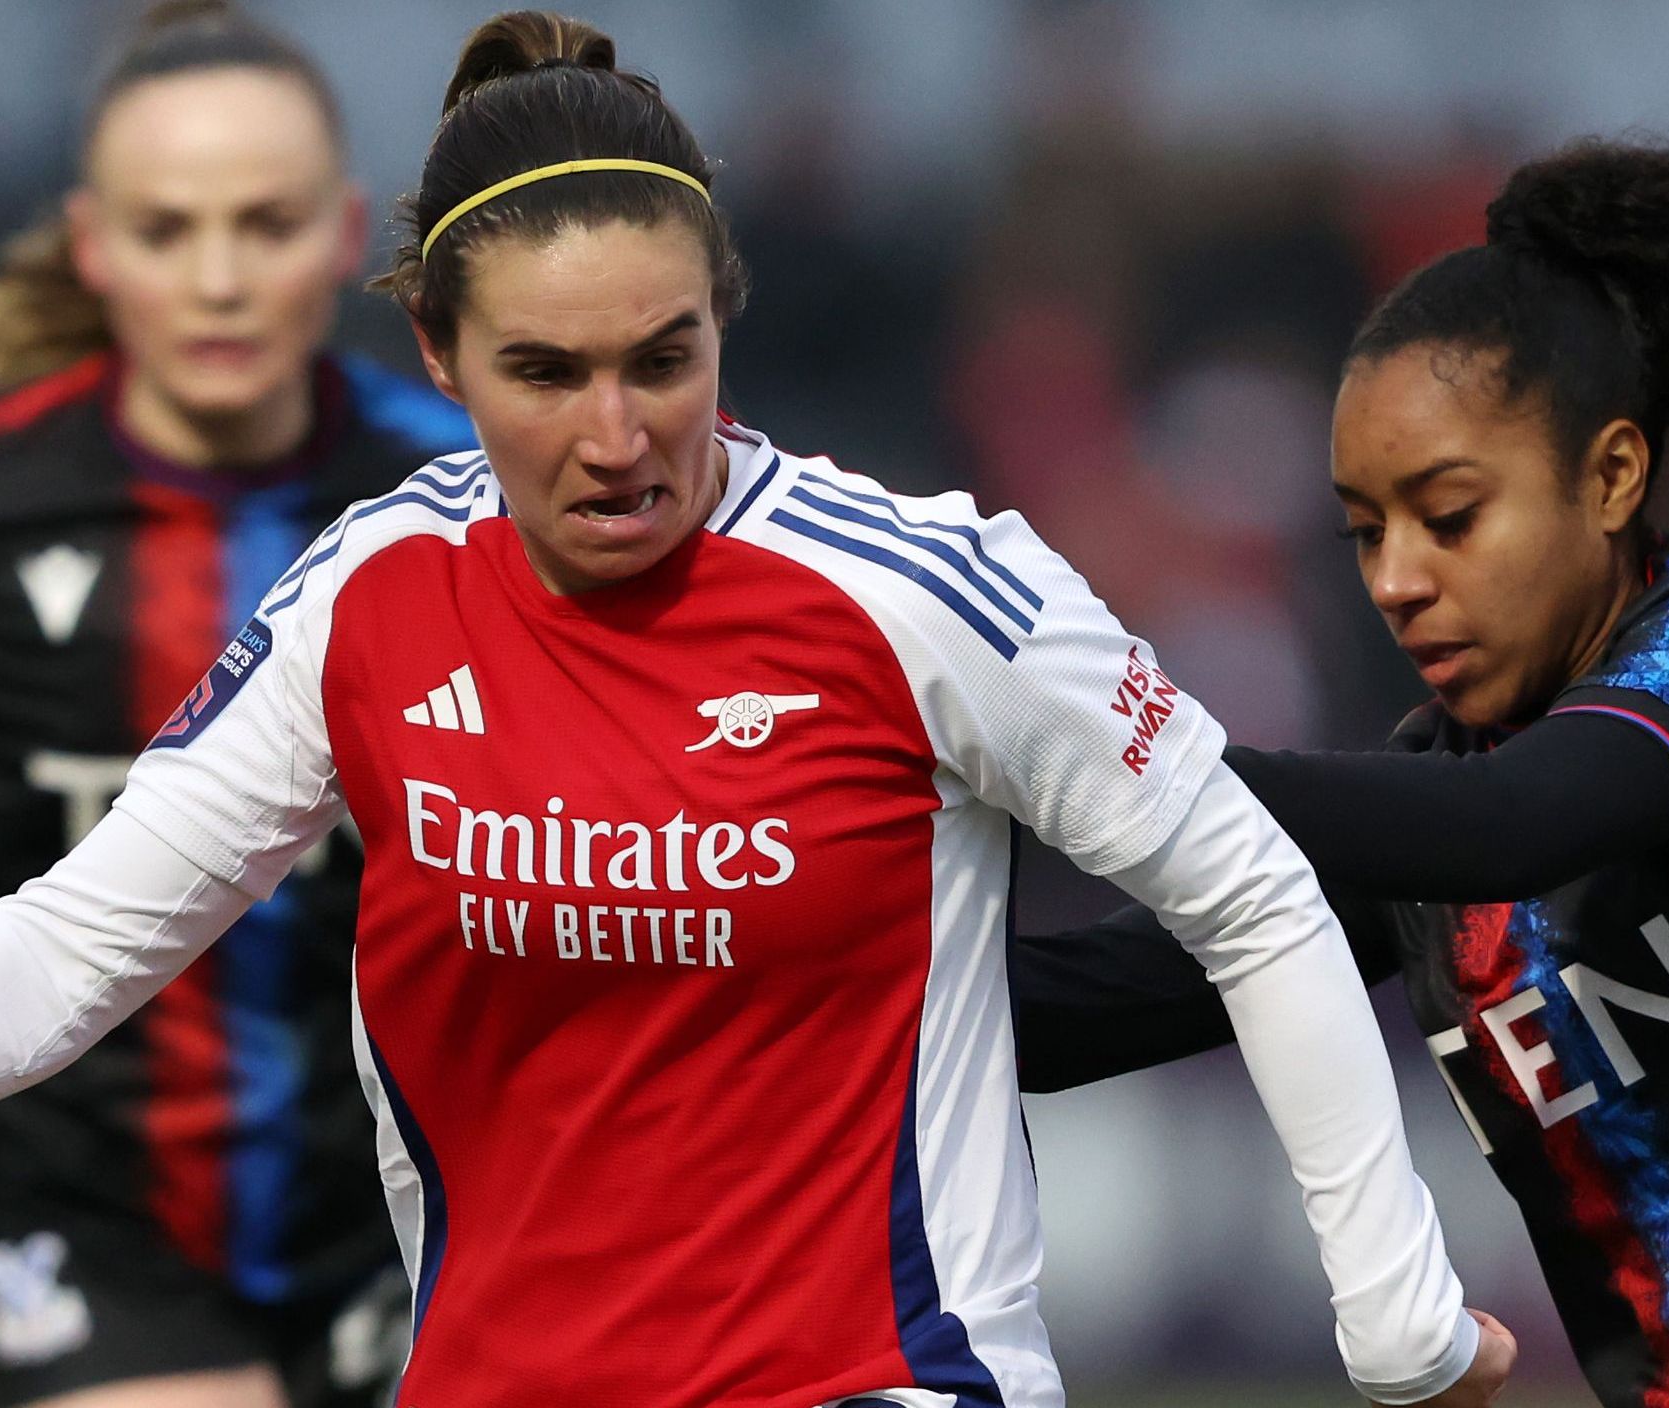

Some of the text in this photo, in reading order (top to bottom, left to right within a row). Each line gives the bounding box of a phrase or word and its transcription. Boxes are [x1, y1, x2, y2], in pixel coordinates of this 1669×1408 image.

[217, 653, 244, 679] EAGUE
[1121, 667, 1178, 777] RWAN
[401, 777, 796, 892] Emirates
[458, 891, 735, 968] FLY BETTER
